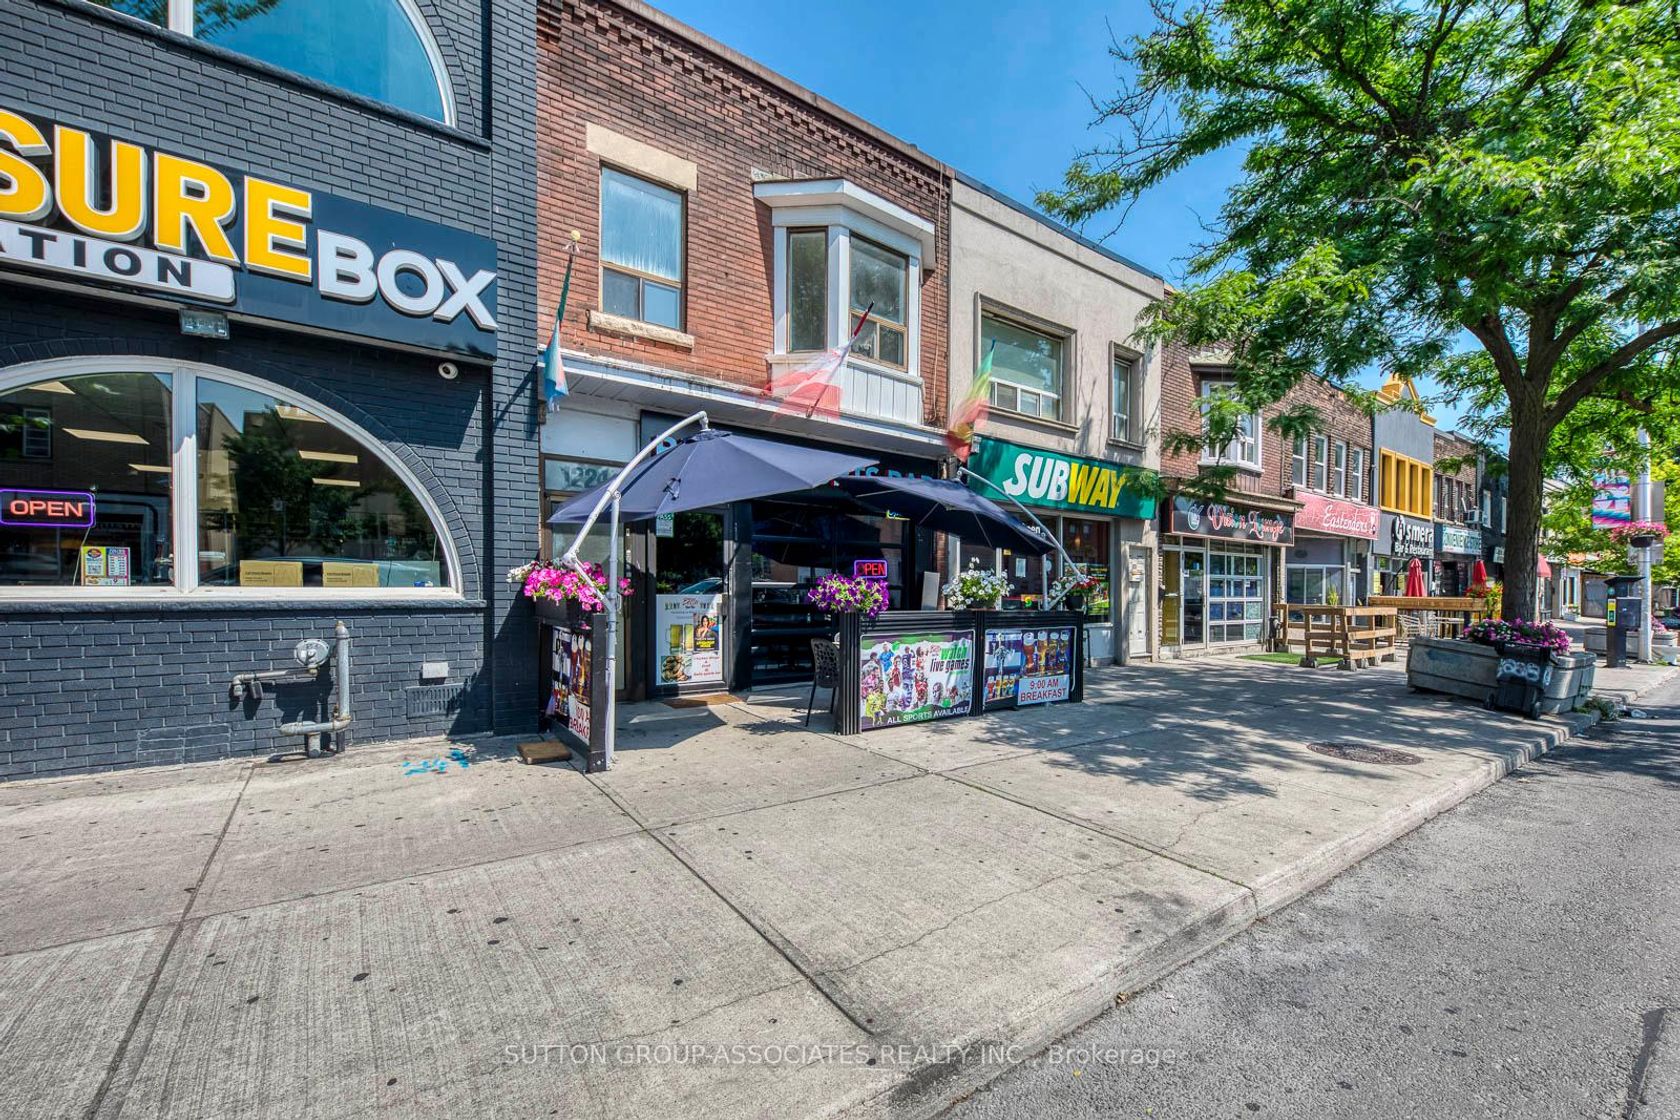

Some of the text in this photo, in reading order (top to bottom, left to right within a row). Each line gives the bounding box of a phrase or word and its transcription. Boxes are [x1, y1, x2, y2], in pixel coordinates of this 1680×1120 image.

[0, 226, 192, 288] TION
[1003, 452, 1127, 509] SUBWAY
[10, 500, 83, 518] OPEN
[1323, 504, 1368, 532] Eastenders
[940, 639, 968, 660] watch
[930, 658, 970, 674] live games
[1030, 678, 1059, 690] 9:00 AM
[1020, 687, 1067, 702] BREAKFAST
[887, 706, 969, 724] ALL SPORTS AVAILABLE
